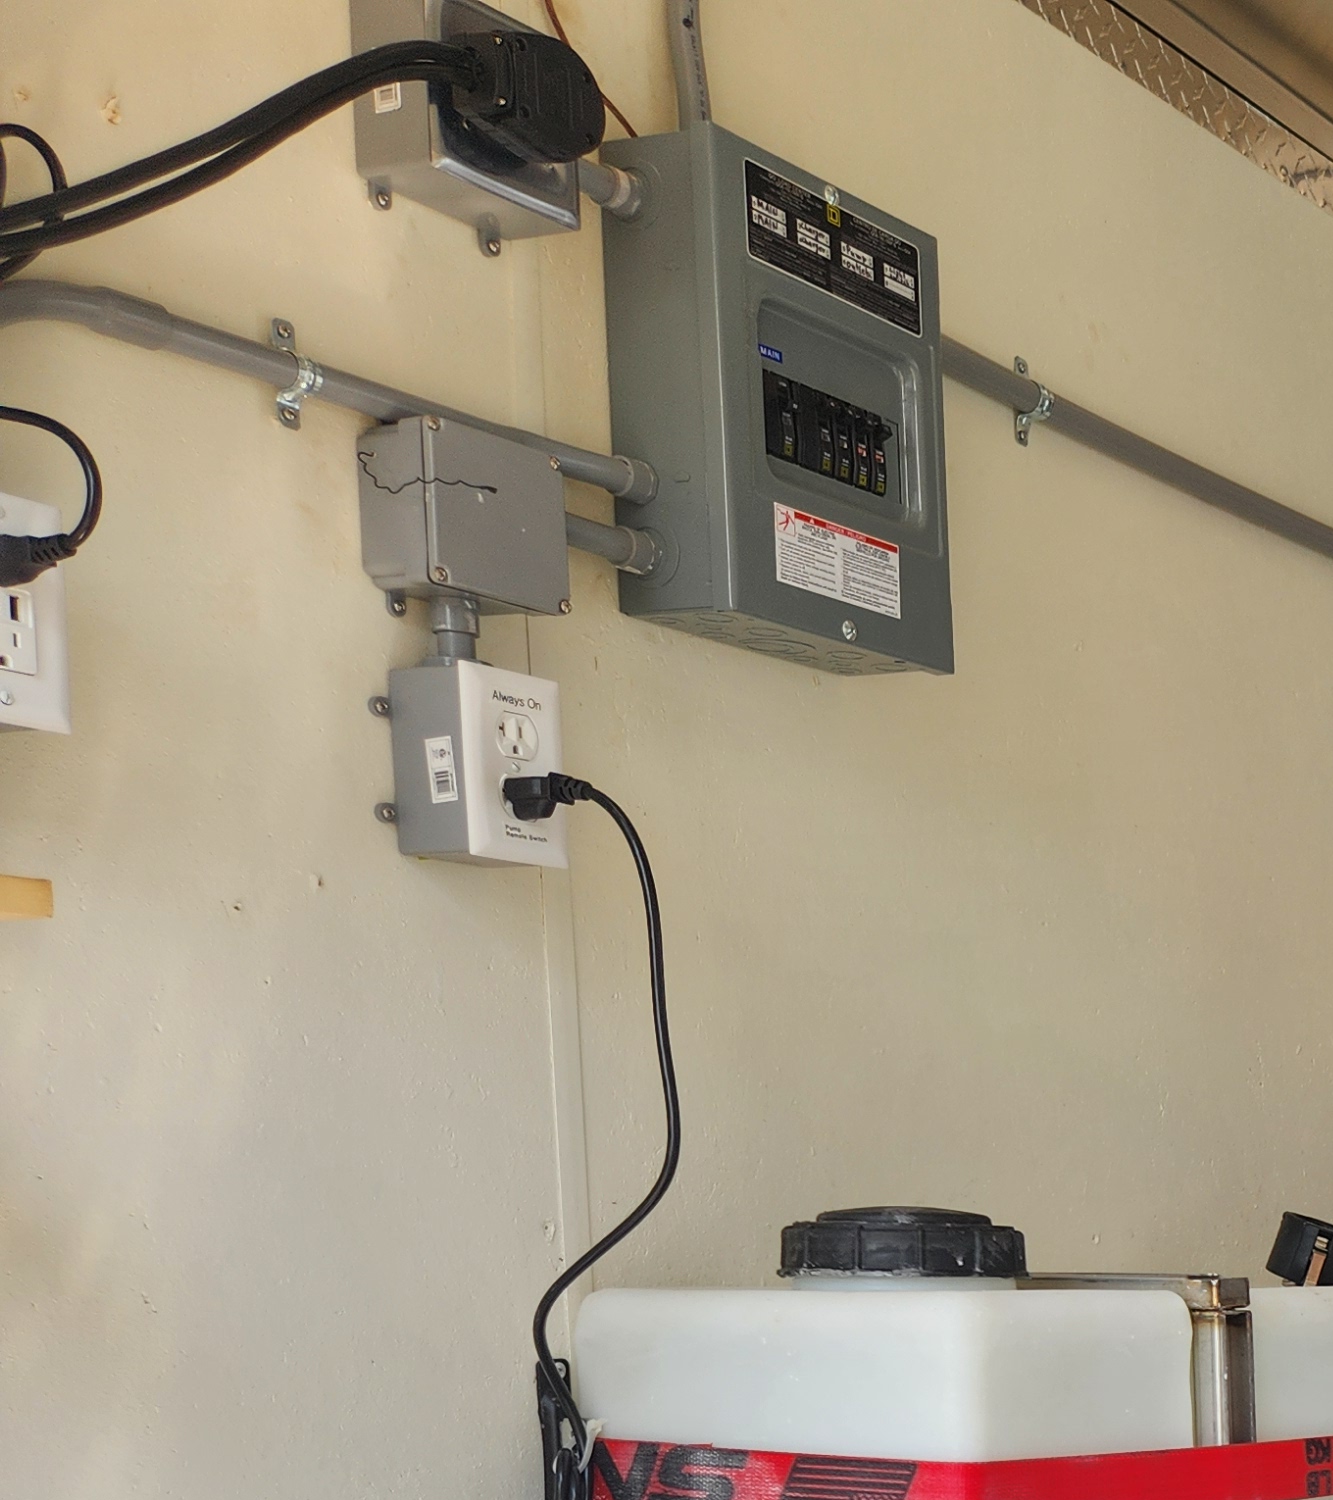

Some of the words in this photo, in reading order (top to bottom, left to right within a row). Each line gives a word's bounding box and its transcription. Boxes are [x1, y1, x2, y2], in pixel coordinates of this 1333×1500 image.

[760, 346, 781, 361] MAIN
[492, 690, 525, 708] Always
[528, 698, 542, 711] On
[505, 824, 521, 833] Pump
[506, 831, 527, 840] Remote
[529, 834, 548, 843] Switch
[1305, 1439, 1332, 1465] KG
[1306, 1470, 1332, 1497] LB
